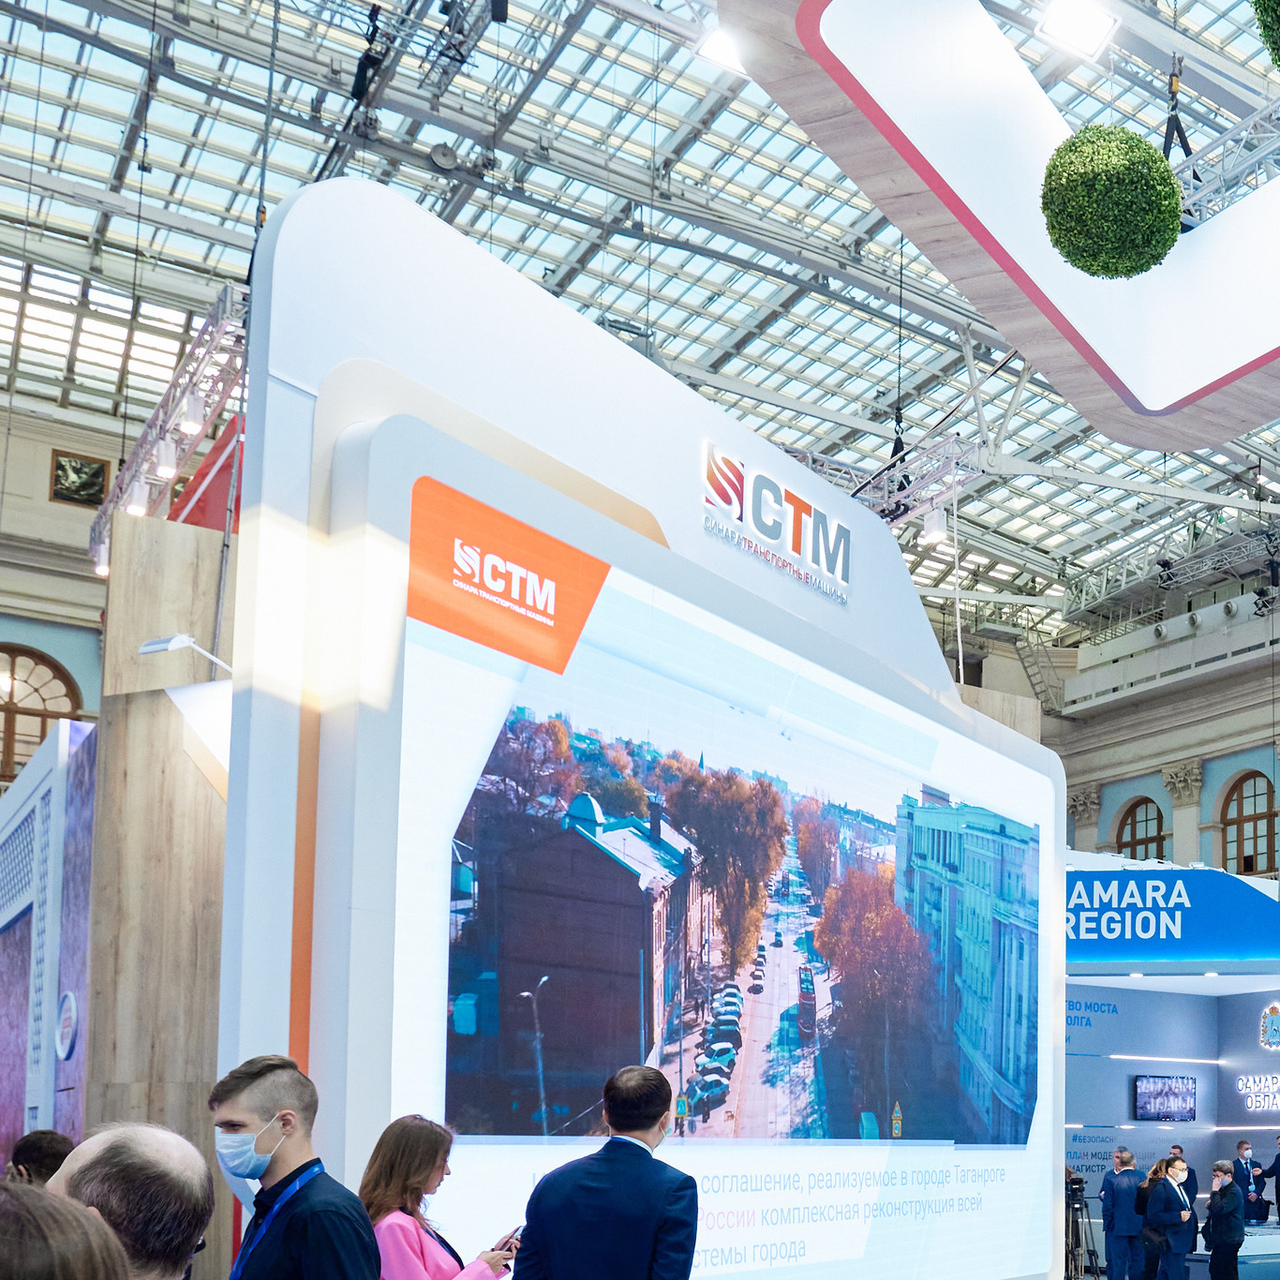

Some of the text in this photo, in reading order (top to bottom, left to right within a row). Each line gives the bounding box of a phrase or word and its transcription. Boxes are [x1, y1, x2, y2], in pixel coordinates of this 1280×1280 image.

[742, 536, 810, 584] ТРАНСПОРТНЫЕ
[1066, 910, 1182, 940] REGION
[1084, 1001, 1119, 1015] МОСТА
[701, 1165, 1006, 1196] соглашение, реализуемое в городе Таганроге
[760, 1201, 860, 1227] комплексная
[863, 1198, 955, 1225] реконструкция
[957, 1192, 983, 1213] всей
[752, 1239, 806, 1269] города
